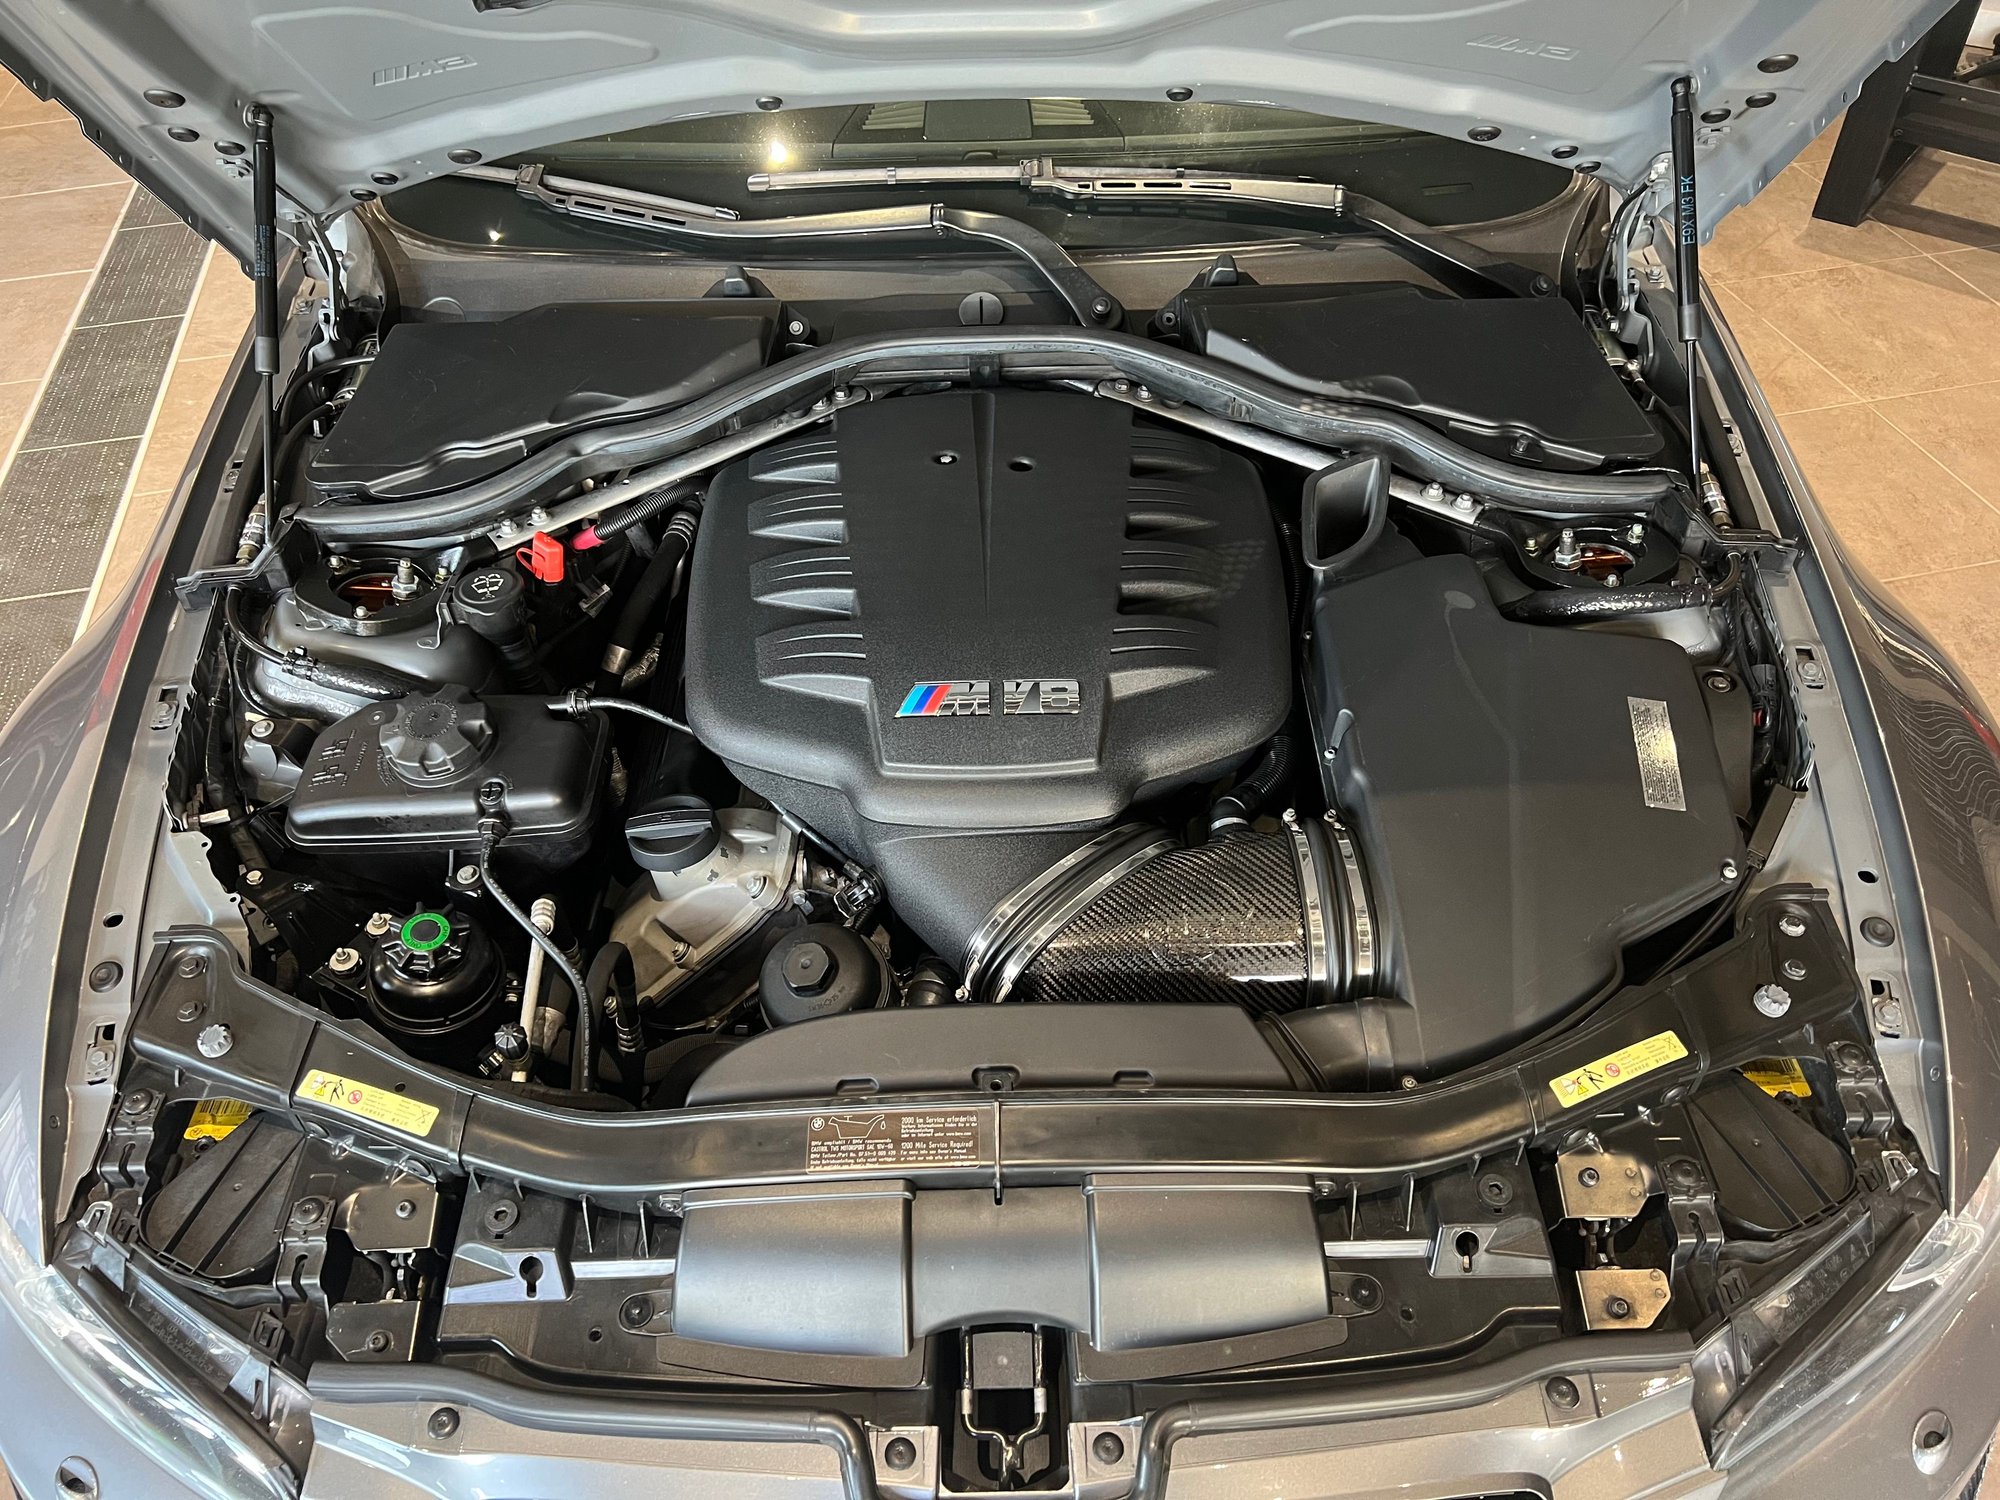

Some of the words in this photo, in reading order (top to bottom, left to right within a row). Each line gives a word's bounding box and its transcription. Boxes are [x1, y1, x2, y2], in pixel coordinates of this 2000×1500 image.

[1681, 175, 1694, 193] FK
[1682, 197, 1695, 215] M3
[1682, 219, 1695, 245] E9X
[935, 680, 990, 717] M
[1002, 679, 1080, 715] V8
